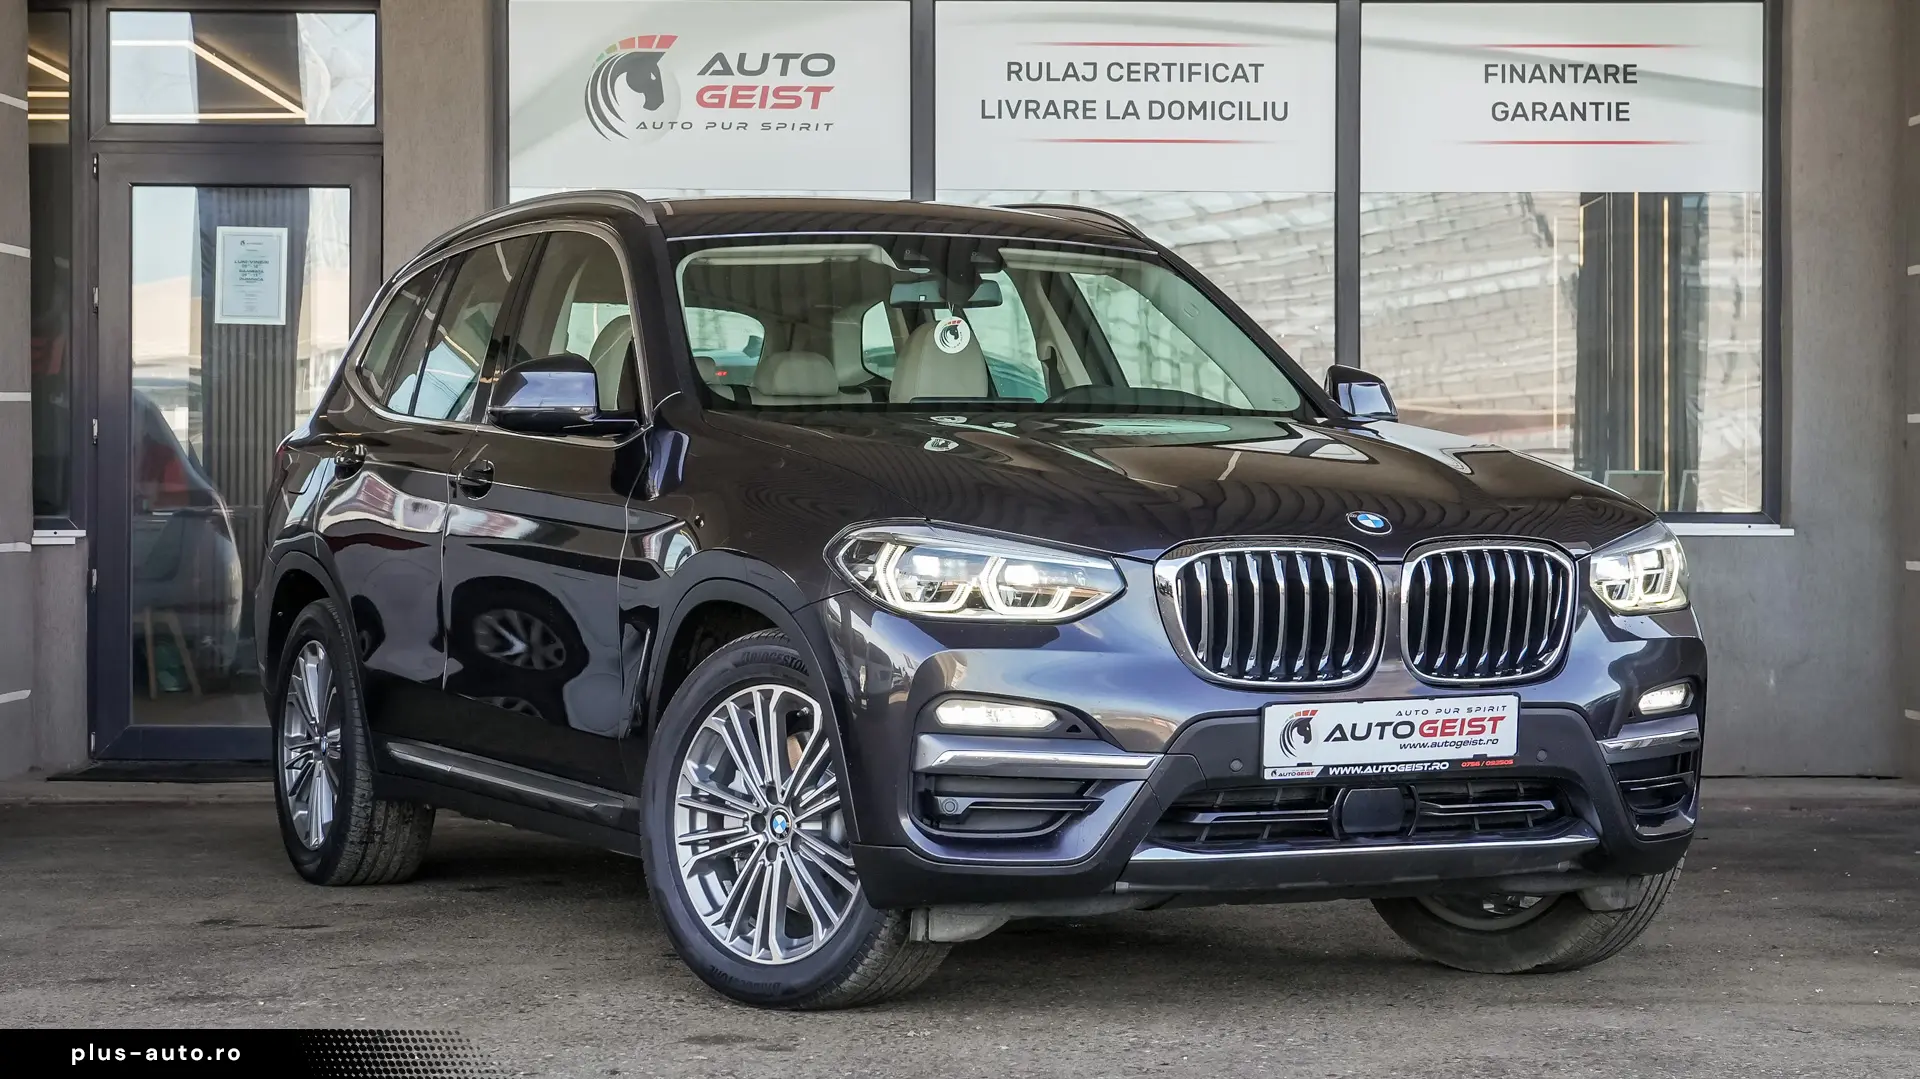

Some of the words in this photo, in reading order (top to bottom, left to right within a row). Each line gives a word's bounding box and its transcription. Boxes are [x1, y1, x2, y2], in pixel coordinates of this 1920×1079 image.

[696, 52, 836, 77] AUTO
[1006, 61, 1098, 82] RULAJ
[1106, 62, 1265, 83] CERTIFICAT
[1484, 63, 1638, 84] FINANTARE
[695, 85, 836, 110] GEIST
[981, 99, 1097, 120] LIVRARE
[1105, 99, 1141, 121] LA
[1148, 100, 1289, 122] DOMICILIU
[1491, 101, 1630, 122] GARANTIE
[635, 121, 693, 131] AUTO
[705, 121, 748, 131] PUR
[760, 122, 835, 132] SPIRIT
[1395, 709, 1429, 717] AUTO
[1435, 707, 1460, 715] PUR
[1466, 705, 1507, 714] SPIRIT
[1323, 715, 1507, 743] AUTOGEIST
[1399, 737, 1499, 751] www.autogeist.ro
[1329, 761, 1450, 776] WWW.AUTOGEIST.RO
